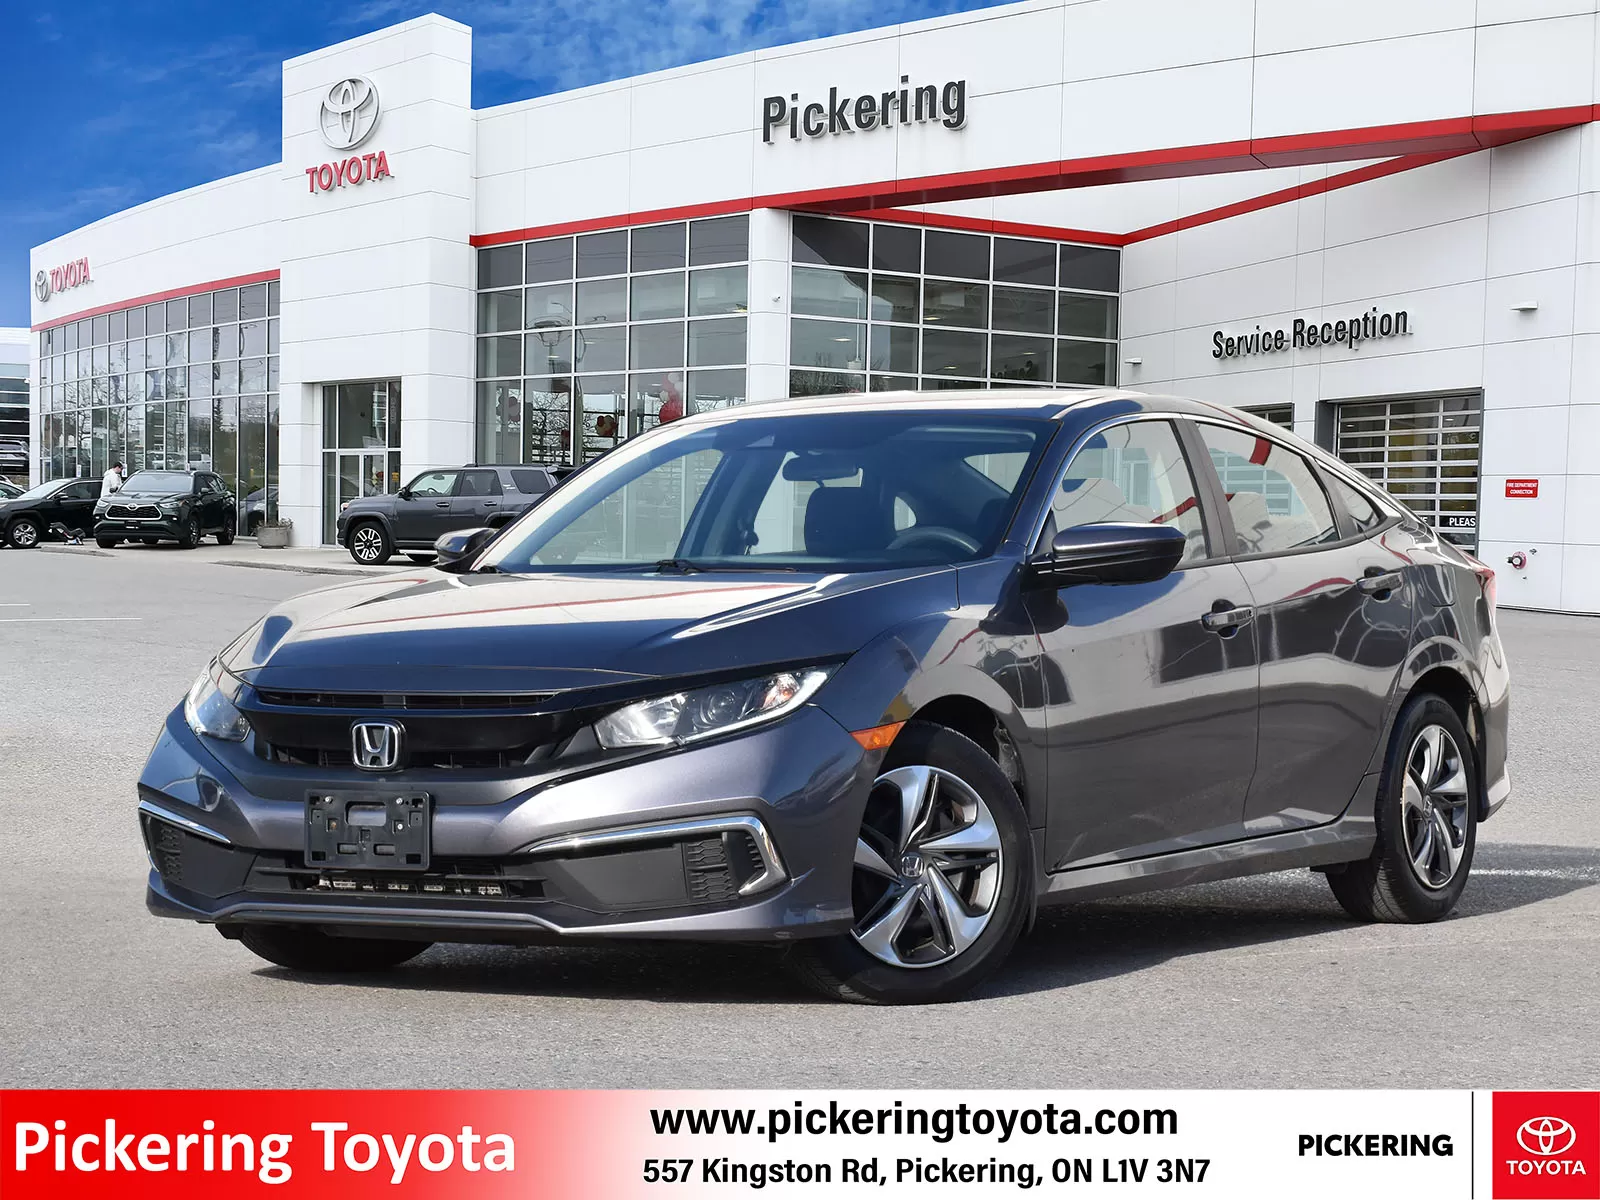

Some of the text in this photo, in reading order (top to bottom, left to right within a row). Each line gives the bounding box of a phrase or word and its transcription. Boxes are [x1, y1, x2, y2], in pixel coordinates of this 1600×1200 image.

[763, 75, 966, 143] Pickering
[305, 150, 391, 193] TOYOTA
[50, 256, 91, 293] TOYOTA
[1212, 307, 1409, 359] Service Reception
